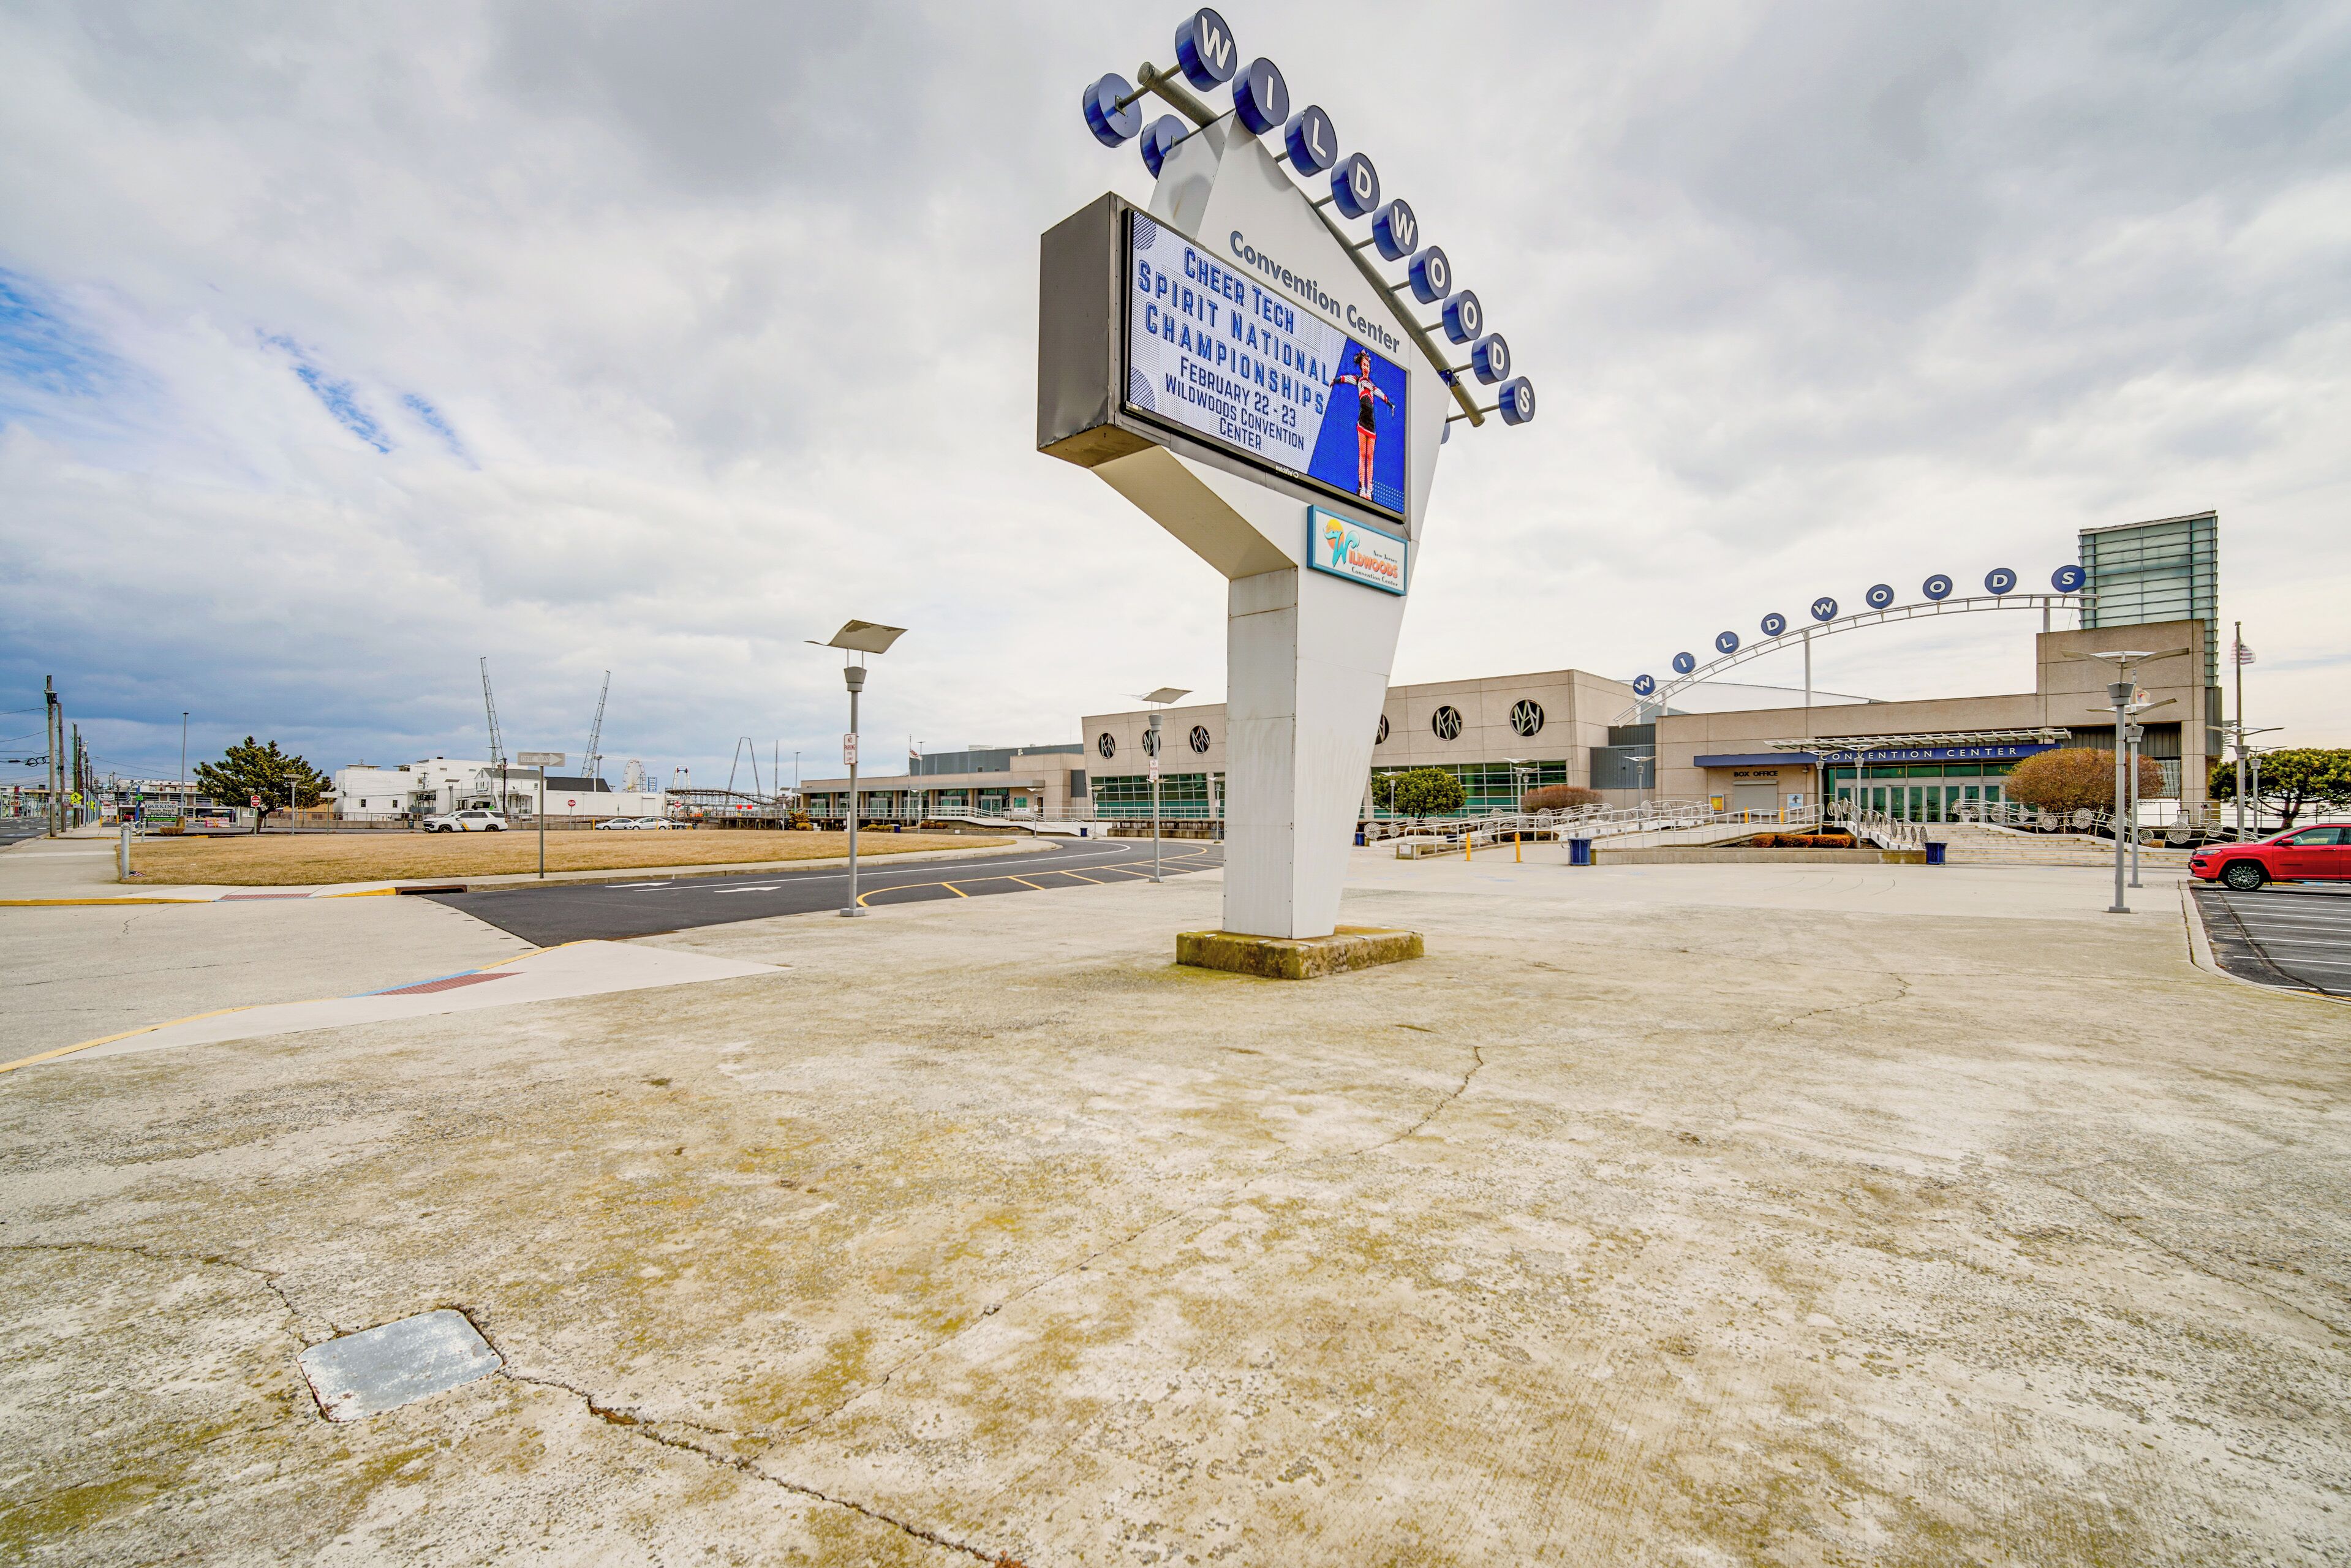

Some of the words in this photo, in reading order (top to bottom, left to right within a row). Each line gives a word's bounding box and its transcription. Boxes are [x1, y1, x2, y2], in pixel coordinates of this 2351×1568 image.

[1201, 14, 1531, 413] WILDWOODS
[1138, 259, 1218, 328] SPIRIT
[1231, 309, 1329, 388] NATIONAL
[1184, 246, 1245, 307] CHEER
[1252, 285, 1294, 334] TECH
[1230, 230, 1341, 319] Convention
[1346, 304, 1400, 353] Center
[1145, 301, 1324, 415] CHAMPIONSHIPS
[1180, 355, 1250, 406] FEBRUARY
[1254, 391, 1269, 417] 22
[1281, 404, 1296, 428] 23
[1165, 372, 1237, 421] WILDWOODS
[1240, 407, 1304, 451] CONVENTION
[1220, 417, 1261, 450] CENTER
[1351, 567, 1381, 581] Convention
[1381, 576, 1398, 587] Center
[1634, 571, 2076, 693] WILDWOODS
[1946, 747, 2017, 757] CENTER
